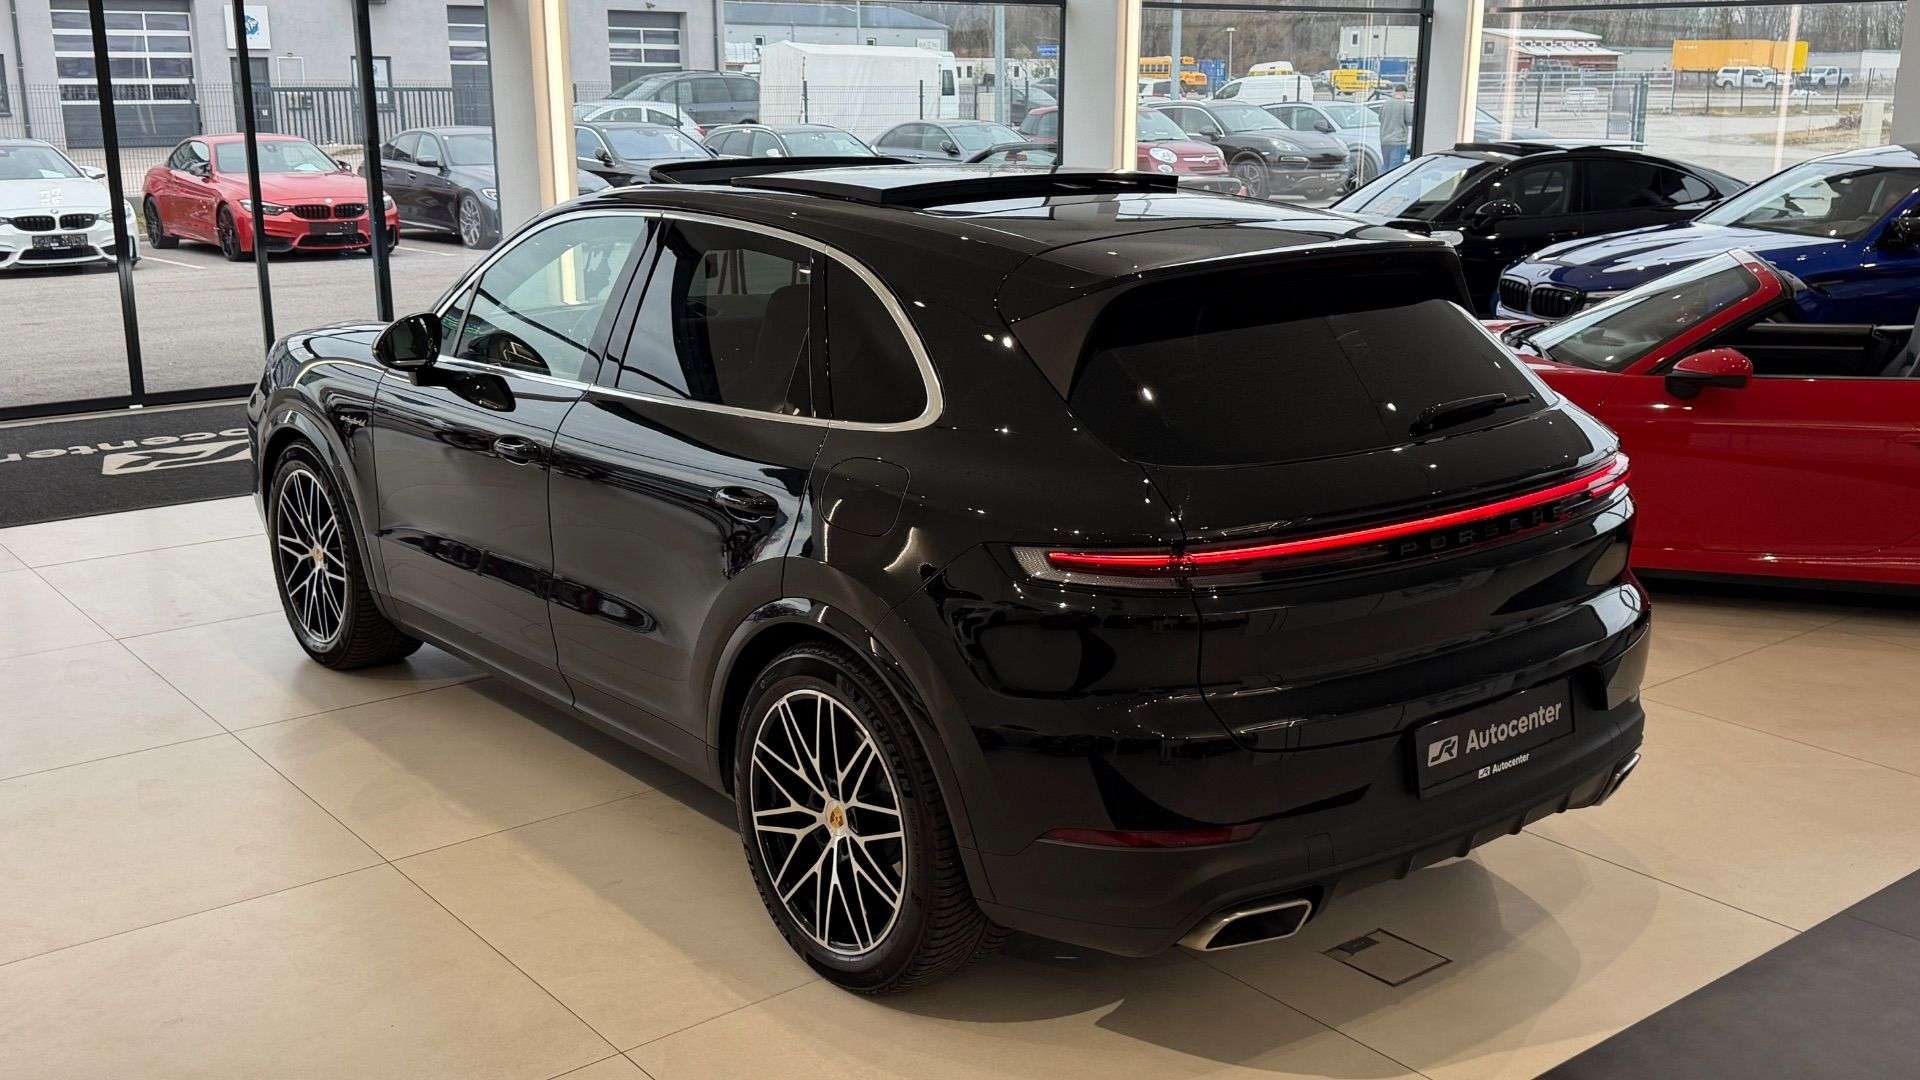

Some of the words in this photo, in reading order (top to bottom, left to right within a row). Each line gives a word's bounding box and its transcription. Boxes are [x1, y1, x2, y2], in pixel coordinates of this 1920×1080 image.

[1400, 504, 1562, 558] PORSCHE
[1465, 702, 1562, 754] Autocenter
[1492, 752, 1530, 775] Autocenter
